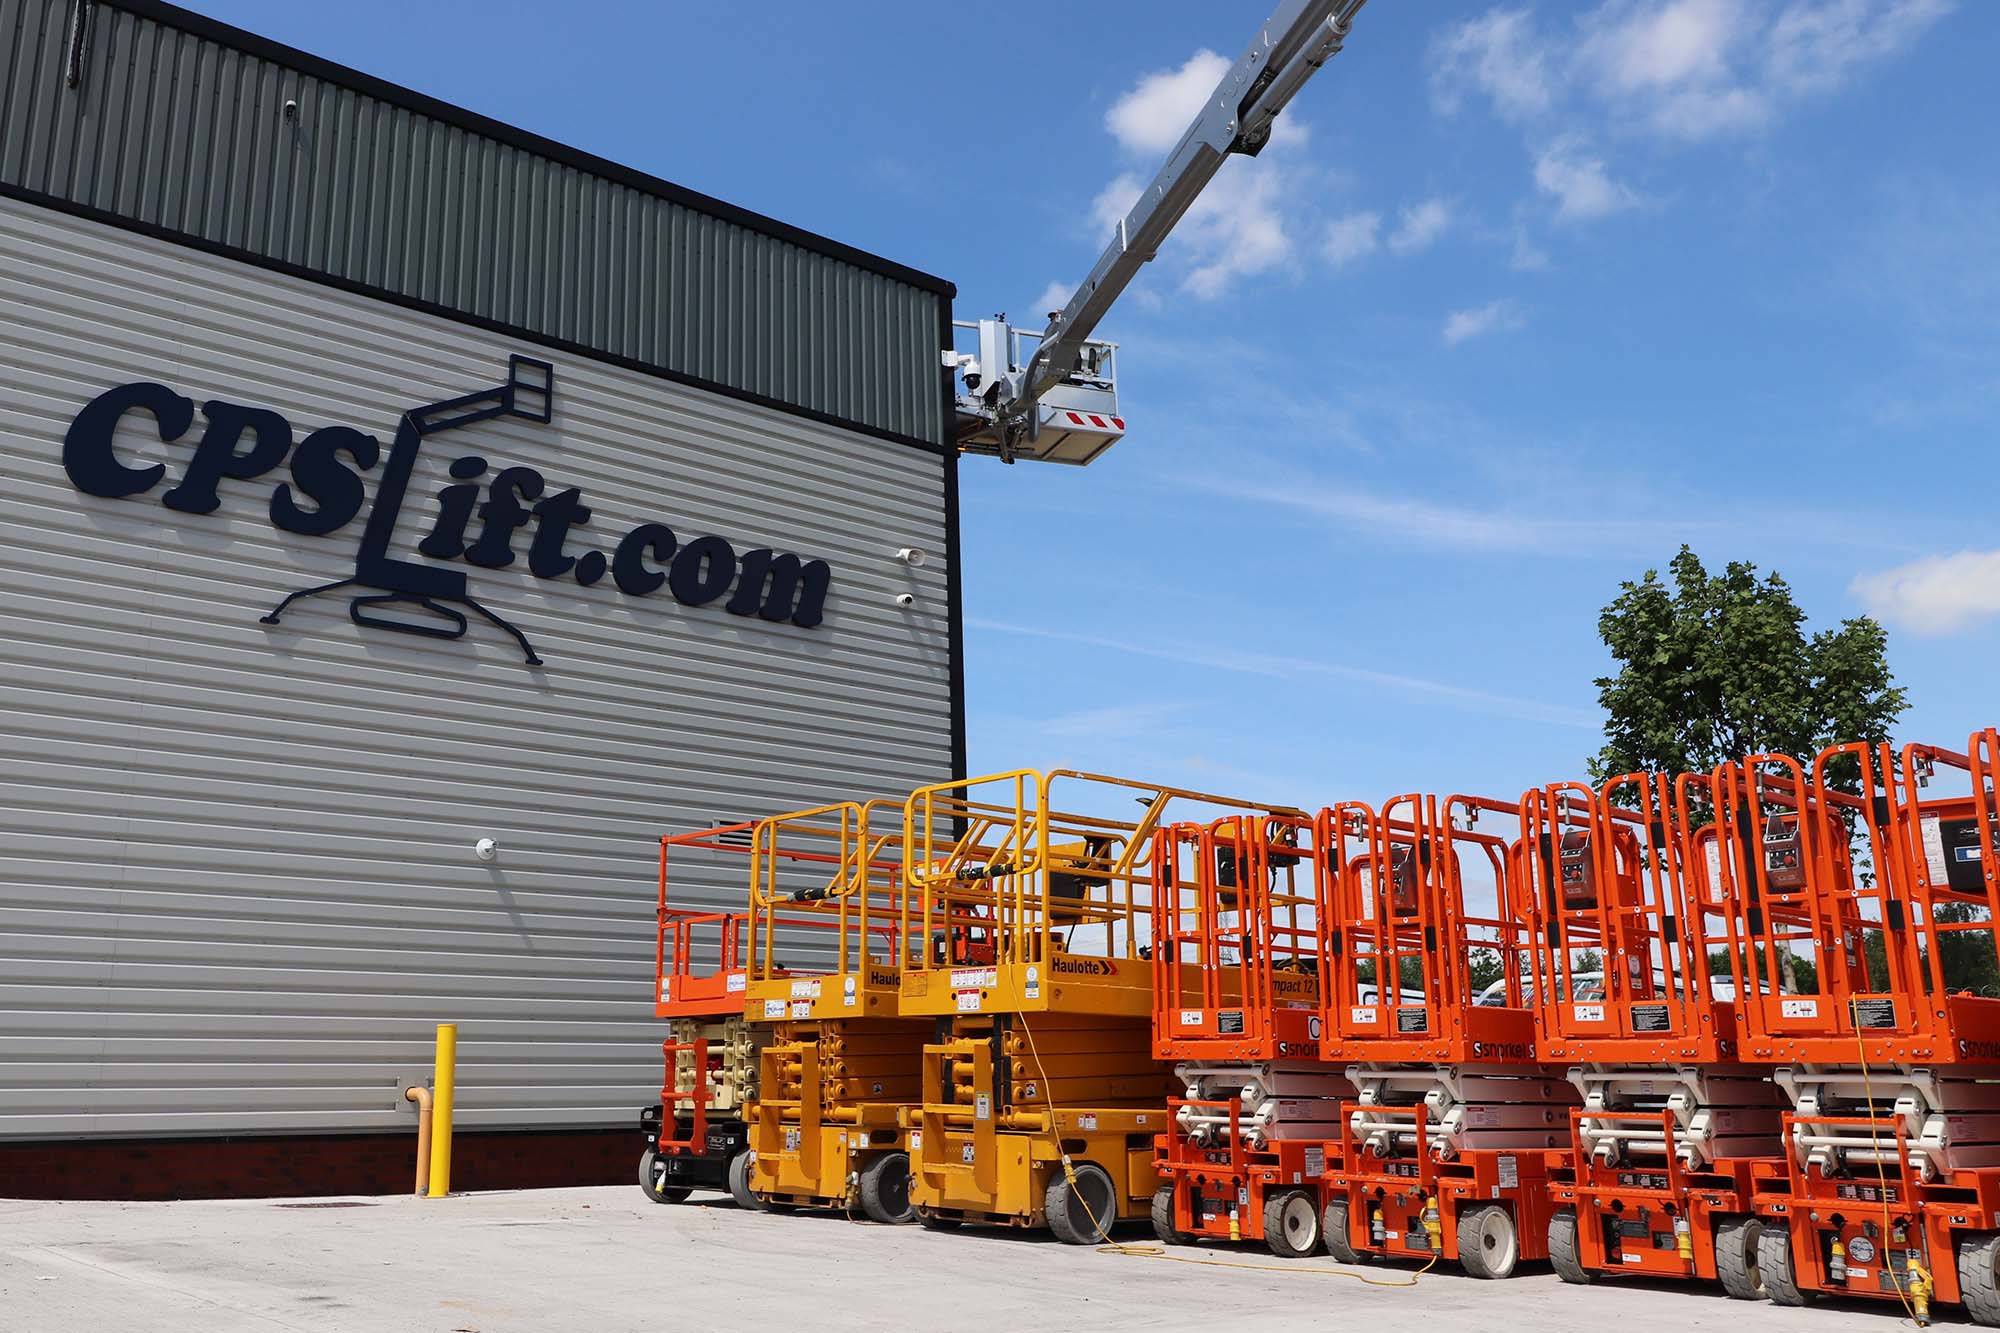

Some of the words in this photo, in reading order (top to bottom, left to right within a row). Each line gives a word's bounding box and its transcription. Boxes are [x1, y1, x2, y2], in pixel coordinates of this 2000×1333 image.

[1052, 957, 1100, 975] Haulotte
[1261, 975, 1302, 995] mpact
[1304, 979, 1313, 993] 12
[1483, 1042, 1527, 1058] snorkel
